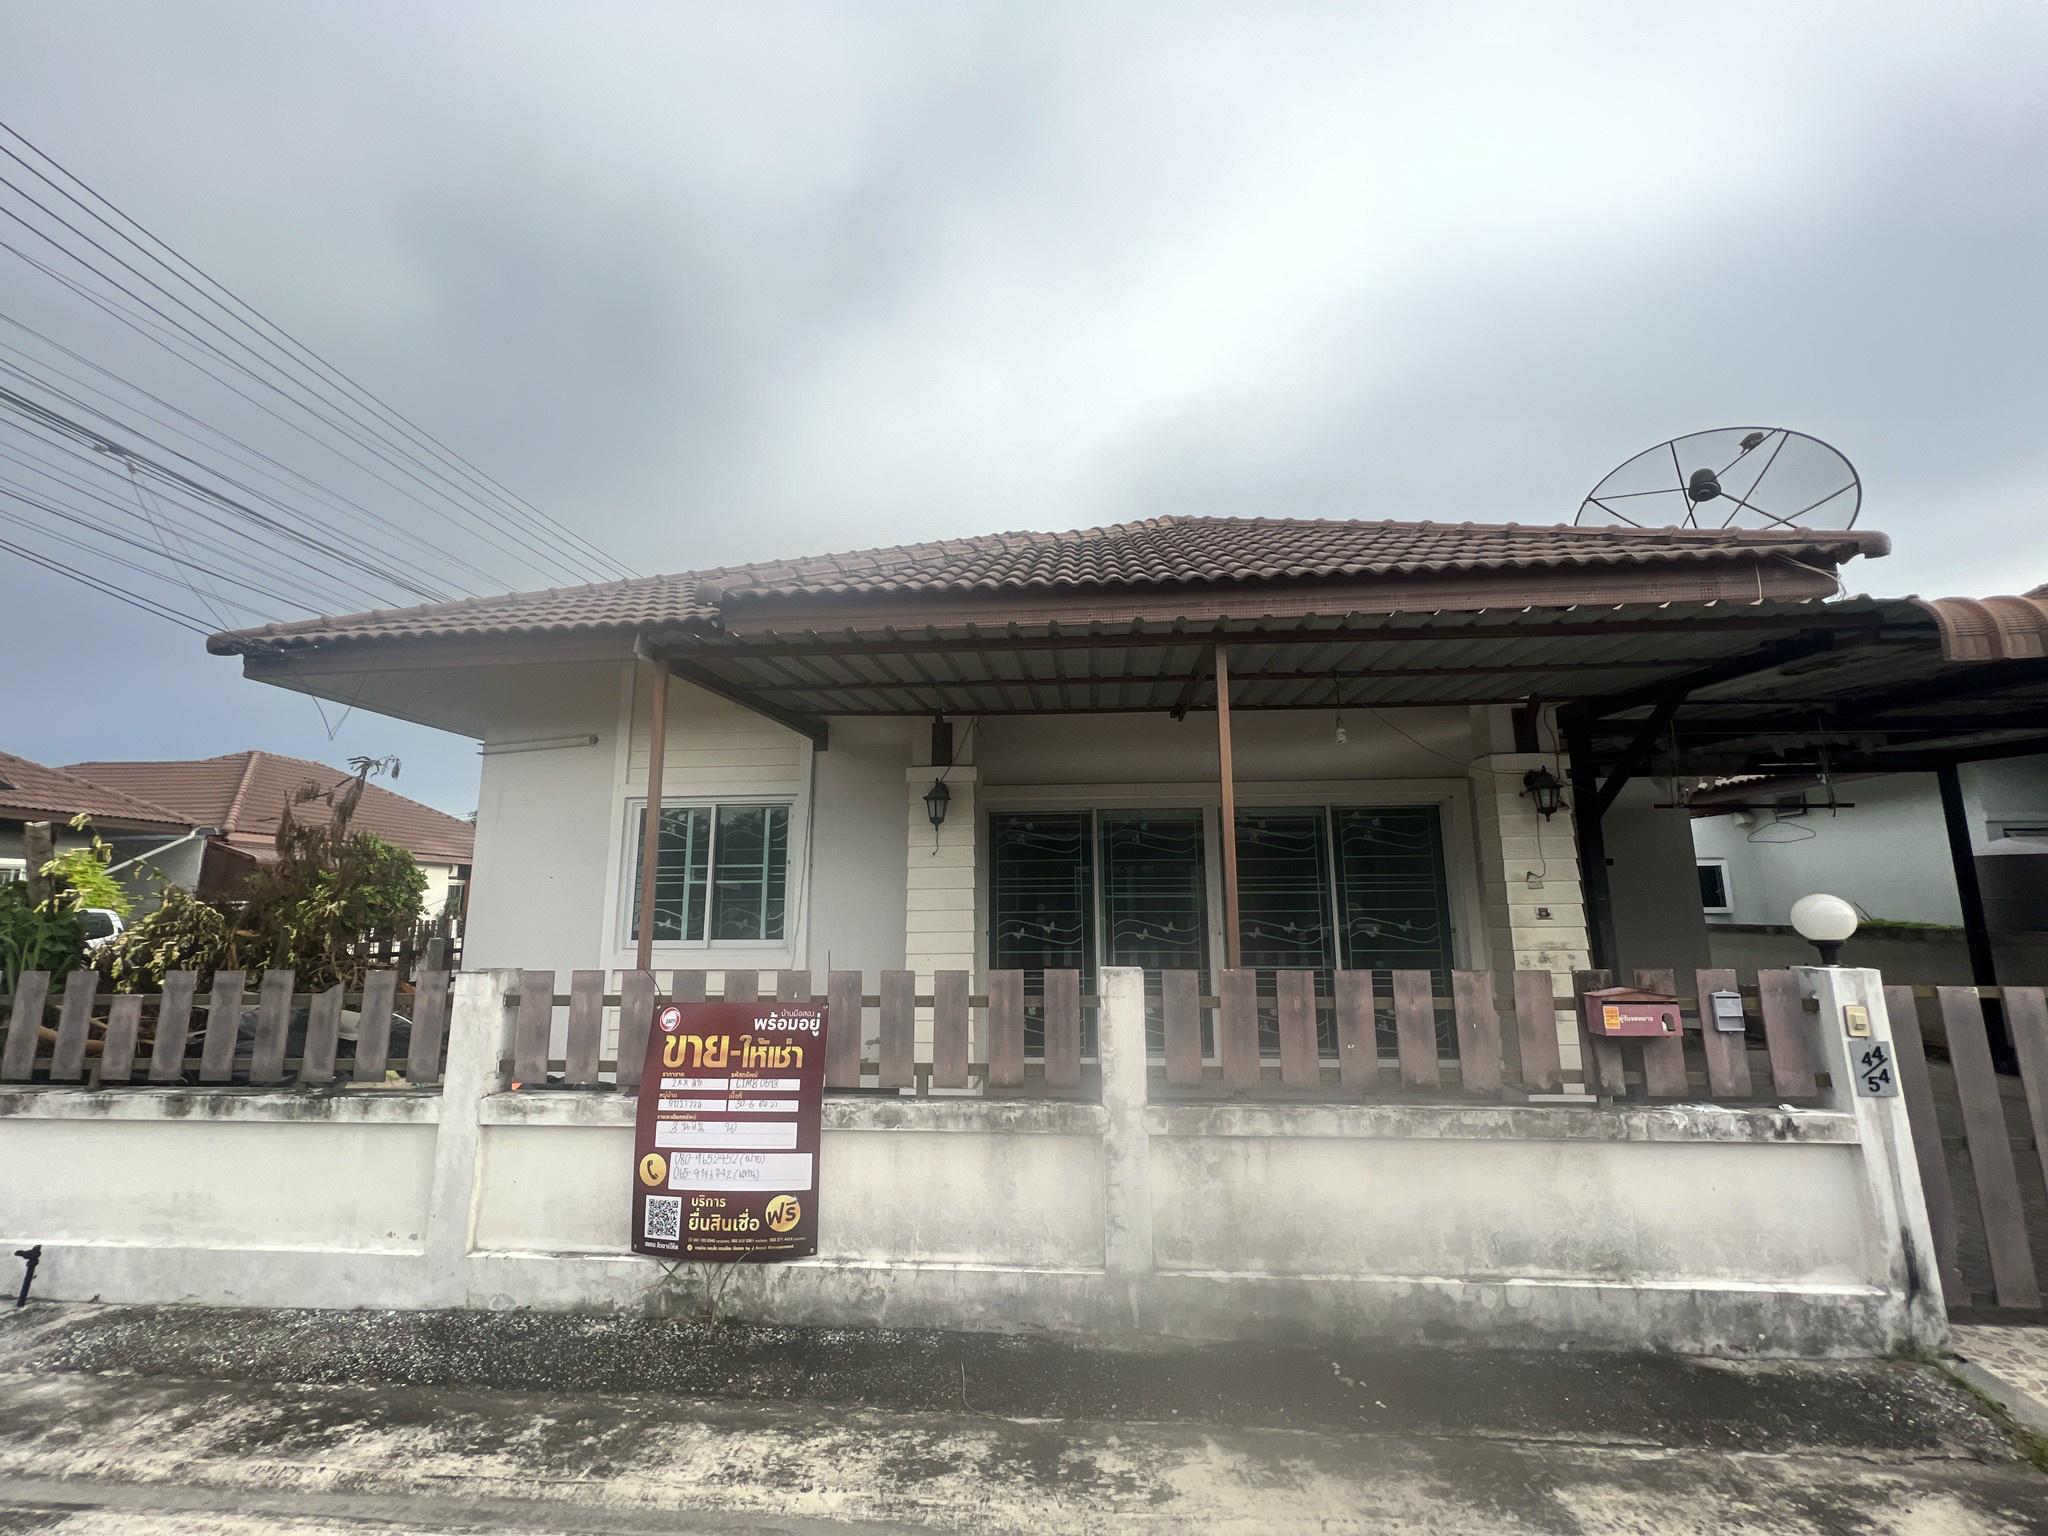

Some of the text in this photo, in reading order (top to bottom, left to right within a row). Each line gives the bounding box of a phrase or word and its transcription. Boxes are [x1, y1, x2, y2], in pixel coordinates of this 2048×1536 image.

[754, 1012, 821, 1037] พร้อมอยู่
[781, 1009, 815, 1017] บ้านมือสอง
[691, 1195, 726, 1207] บริการ
[767, 1200, 797, 1226] ฟรี
[688, 1208, 760, 1232] ยื่นสินเชื่อ
